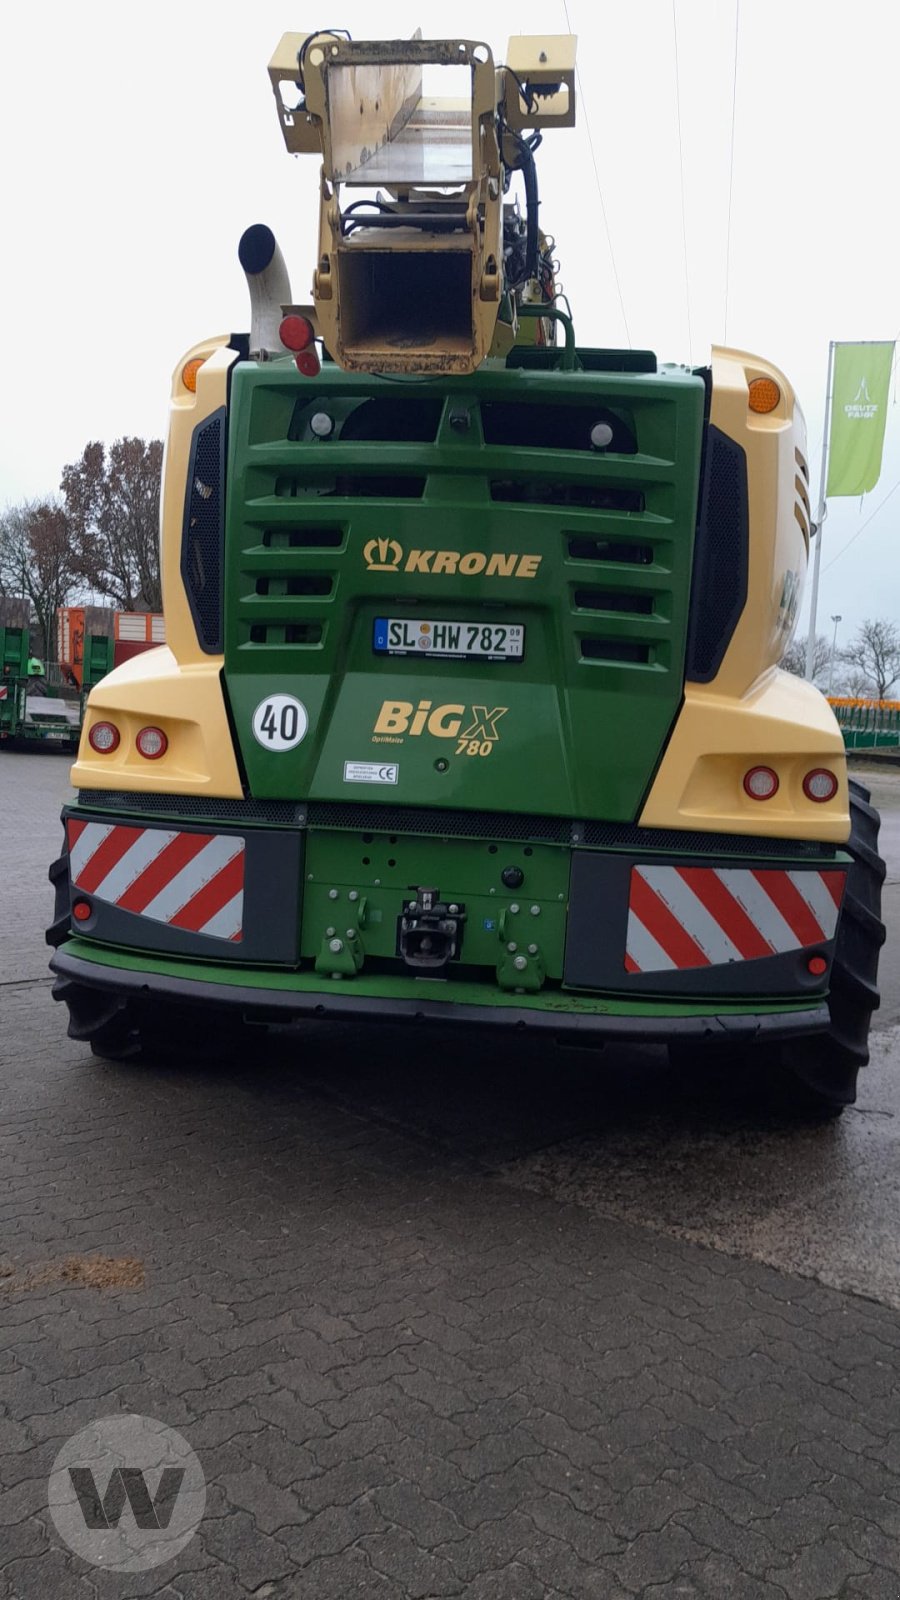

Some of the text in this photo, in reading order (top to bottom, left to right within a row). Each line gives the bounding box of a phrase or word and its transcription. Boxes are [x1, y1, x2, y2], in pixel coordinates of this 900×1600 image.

[404, 550, 542, 578] KRONE
[389, 622, 507, 652] SL HW 782
[260, 704, 298, 741] 40
[455, 740, 493, 756] 780
